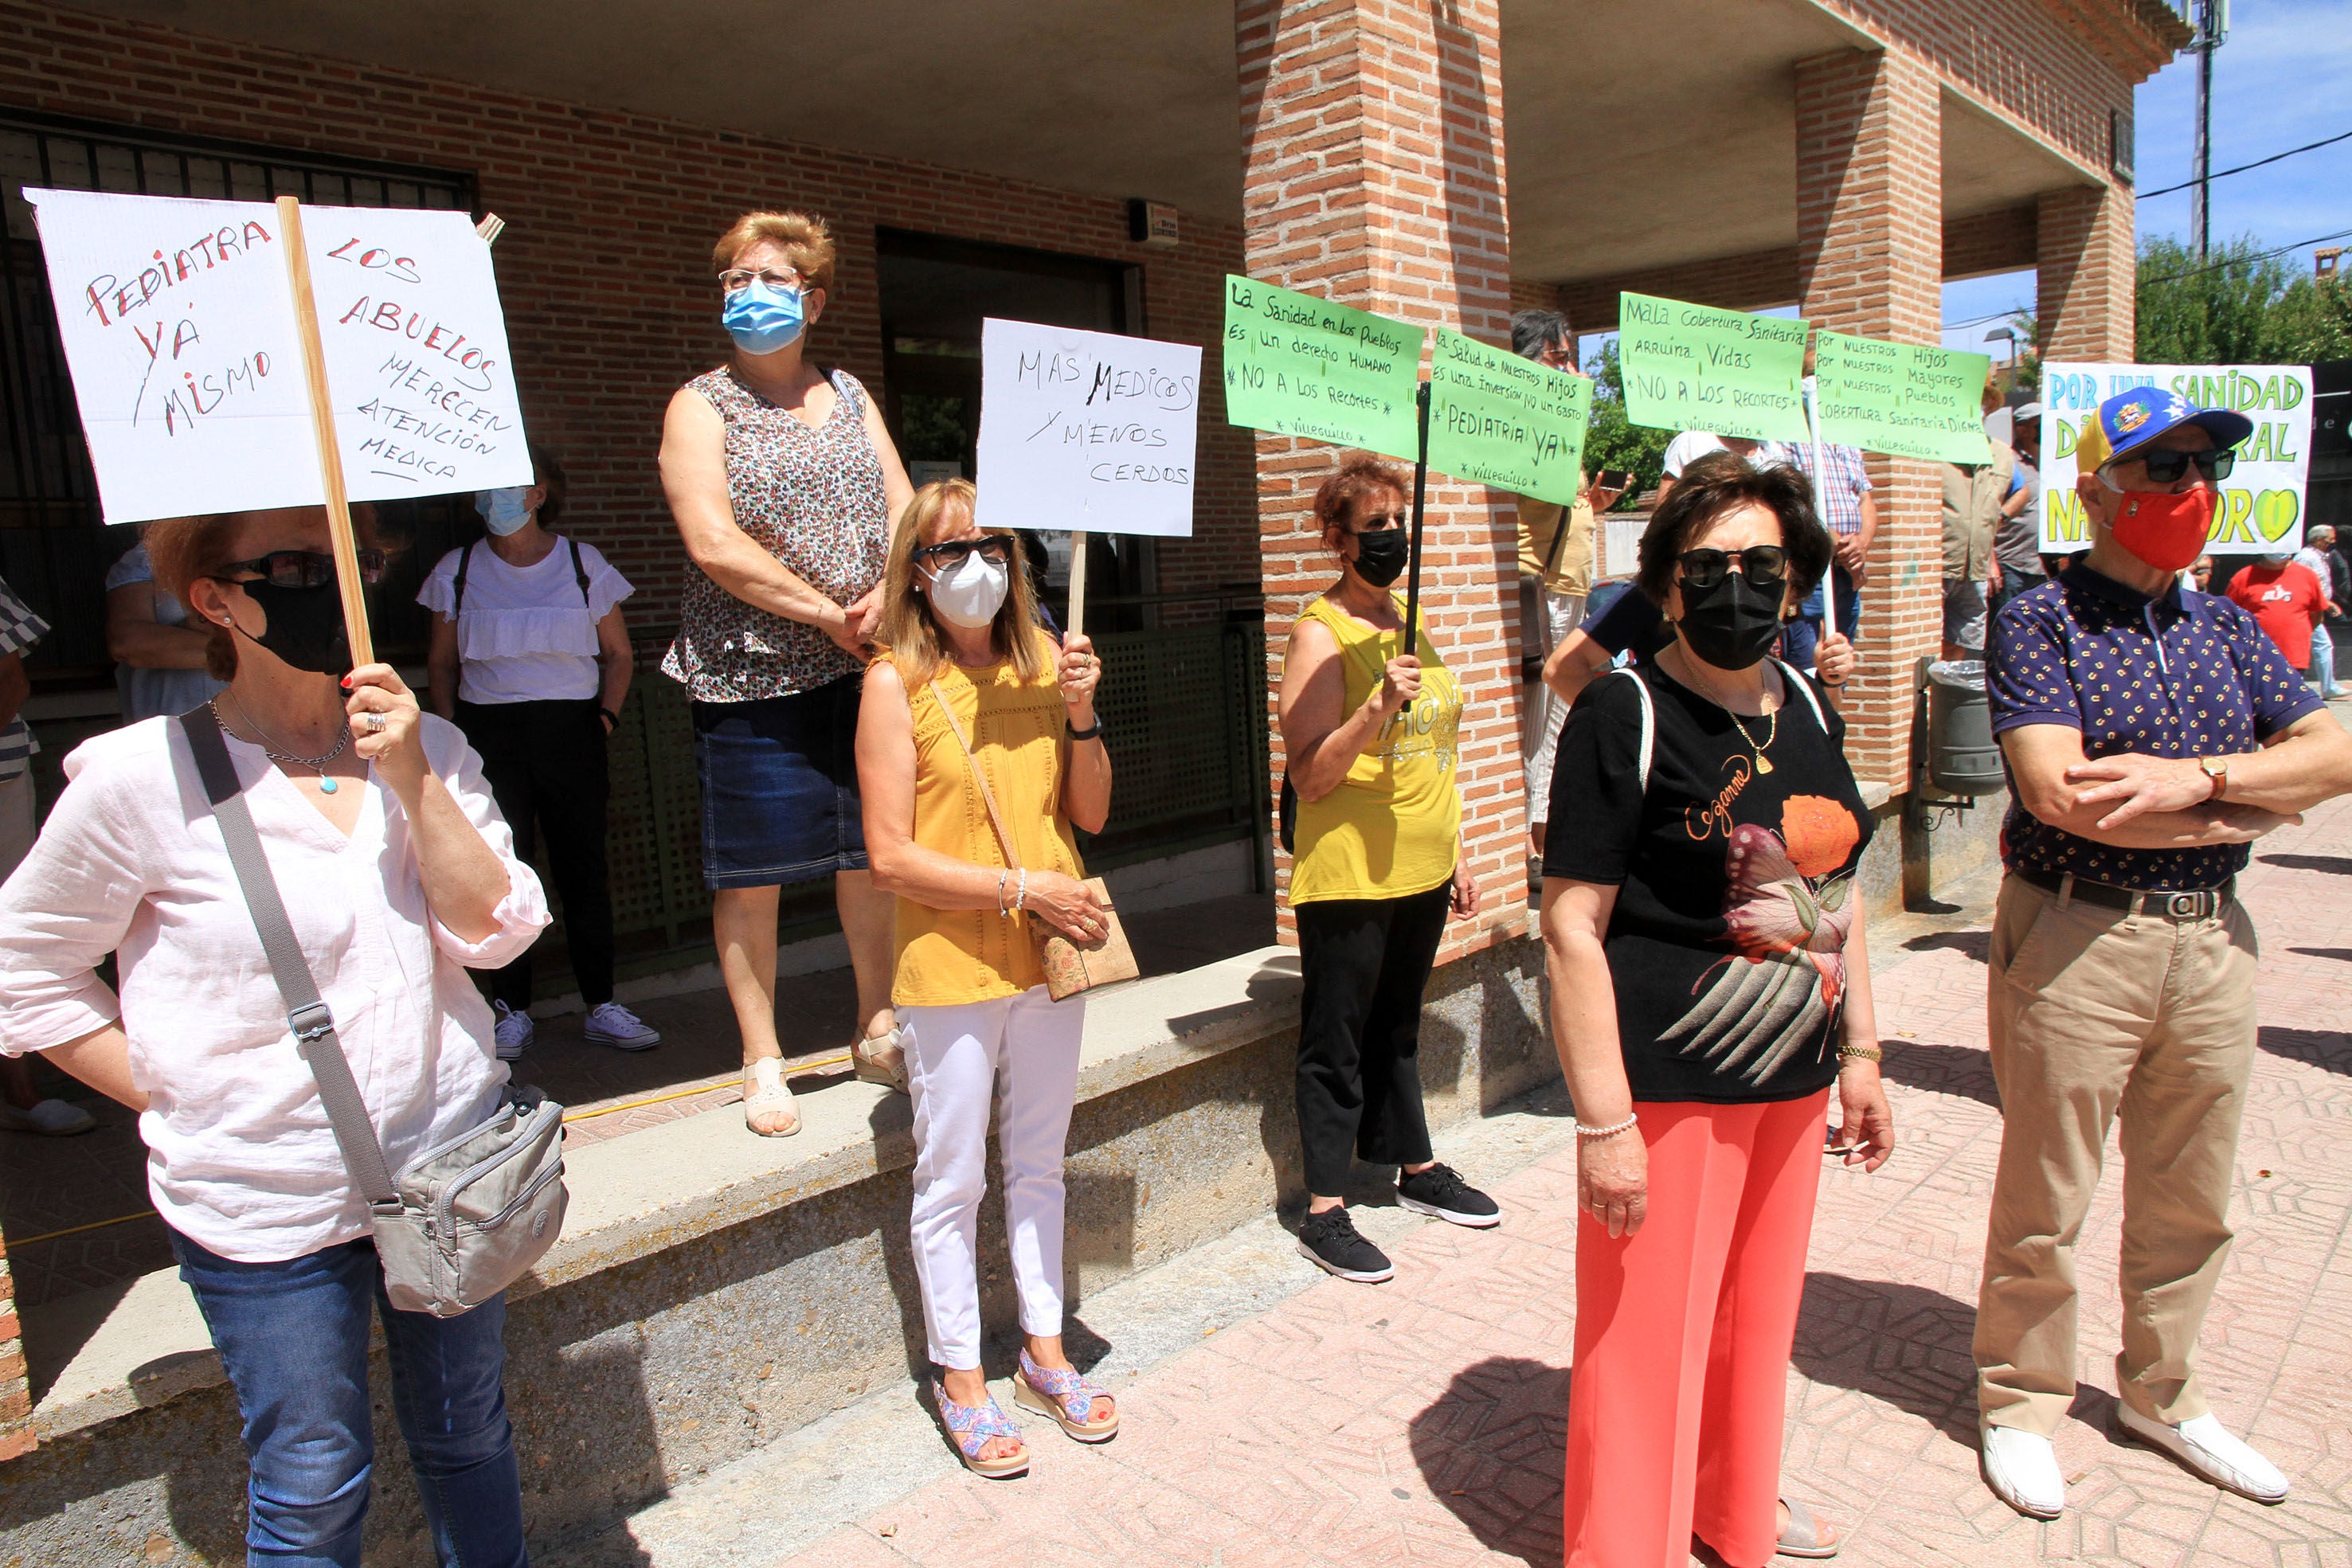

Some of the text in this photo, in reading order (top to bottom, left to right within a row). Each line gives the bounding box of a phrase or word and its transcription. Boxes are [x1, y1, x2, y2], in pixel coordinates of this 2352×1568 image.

[327, 237, 421, 283] LOS
[1231, 282, 1254, 308] La
[1262, 295, 1317, 327] Sanidad
[1322, 318, 1336, 332] en
[1626, 299, 1805, 346] Mala Cobertura Sanitaria
[339, 295, 496, 391] ABUELOS
[1291, 334, 1338, 362] derecho
[1349, 352, 1392, 374] HUMANO
[1705, 342, 1751, 370] Vidas
[1817, 331, 1950, 369] Por NUESTROS Hijos
[1018, 350, 1080, 390] MAS
[1243, 362, 1265, 390] NO
[1277, 372, 1288, 393] A
[1448, 339, 1482, 367] Salud
[1484, 355, 1496, 372] de
[1546, 374, 1578, 401] Hijos
[1816, 353, 1964, 389] Por NUESTROS Mayores
[1816, 373, 1833, 389] Por
[1843, 379, 1892, 395] NUESTROS
[380, 350, 511, 432] MERECEN
[1450, 369, 1475, 389] una
[1523, 393, 1537, 409] NO
[1540, 399, 1554, 413] un
[1637, 373, 1790, 411] NO A LOS RECORTES
[2048, 373, 2099, 410] POR
[1026, 411, 1168, 447] Y MENOS
[1531, 426, 1559, 467] YA
[360, 437, 456, 479] MEDICA
[1090, 463, 1189, 485] CERDOS
